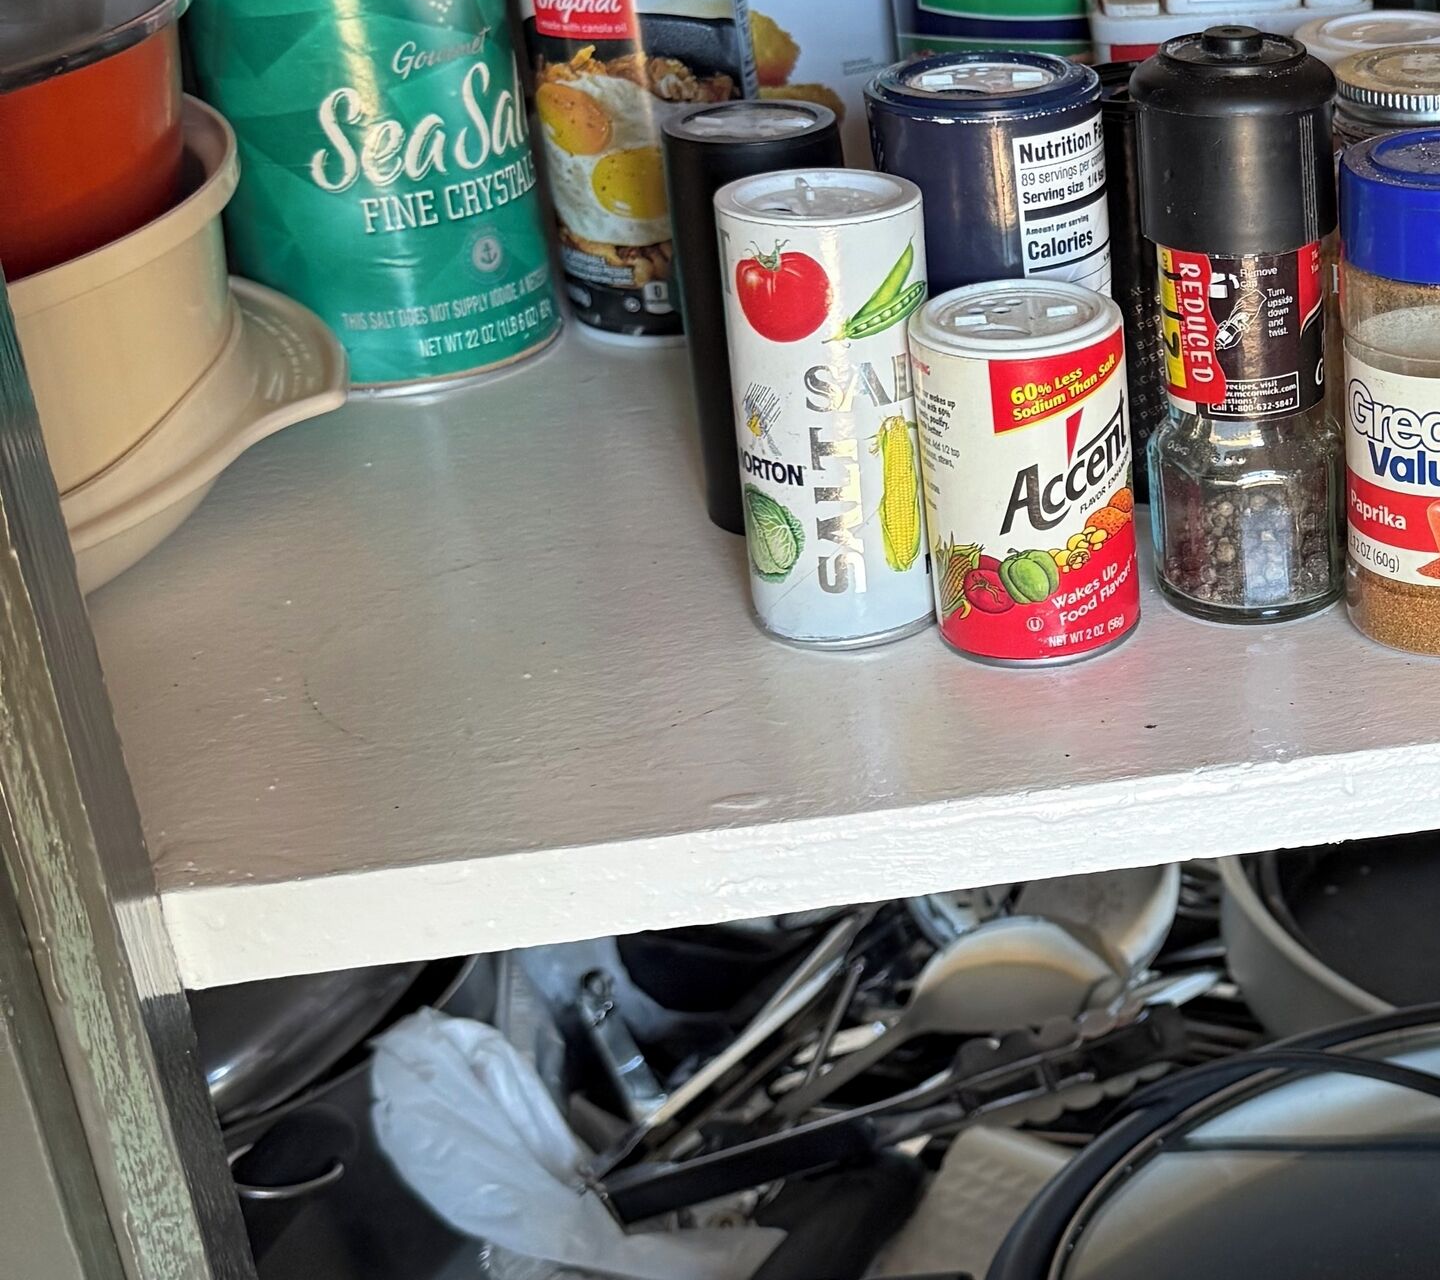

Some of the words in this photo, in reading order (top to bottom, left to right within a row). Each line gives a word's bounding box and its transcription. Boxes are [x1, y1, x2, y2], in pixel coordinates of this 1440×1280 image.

[392, 27, 491, 80] Gourmet
[311, 87, 447, 194] Sea
[1019, 130, 1092, 164] Nutrition
[1021, 173, 1036, 187] 89
[1039, 164, 1078, 184] servings
[1079, 160, 1090, 175] per
[1023, 185, 1065, 204] Serving
[1067, 181, 1085, 196] size
[361, 190, 438, 234] FINE
[1026, 223, 1055, 236] Amount
[1056, 222, 1067, 233] per
[1069, 213, 1089, 229] serving
[1028, 229, 1093, 261] Calories
[1240, 266, 1278, 278] Remove
[453, 295, 489, 319] SUPPLY
[1267, 287, 1286, 297] Turn
[1267, 295, 1294, 308] upside
[1178, 262, 1214, 383] REDUCED
[1268, 308, 1289, 318] down
[1268, 318, 1284, 328] and
[418, 336, 443, 358] NET
[444, 332, 463, 353] WT
[465, 329, 480, 350] 22
[481, 325, 498, 347] OZ
[1010, 382, 1052, 405] 60%
[1055, 367, 1083, 390] Less
[1013, 392, 1067, 421] Sodium
[1068, 373, 1098, 398] Than
[1099, 353, 1116, 378] Salt
[1000, 389, 1127, 538] Accent
[809, 427, 867, 594] SALT
[1350, 489, 1407, 530] Paprika
[1373, 548, 1400, 573] (60g)
[1051, 578, 1100, 609] Wakes
[1058, 595, 1098, 626] Food
[1048, 634, 1068, 648] NET
[1069, 630, 1084, 644] WT
[1086, 628, 1092, 640] 2
